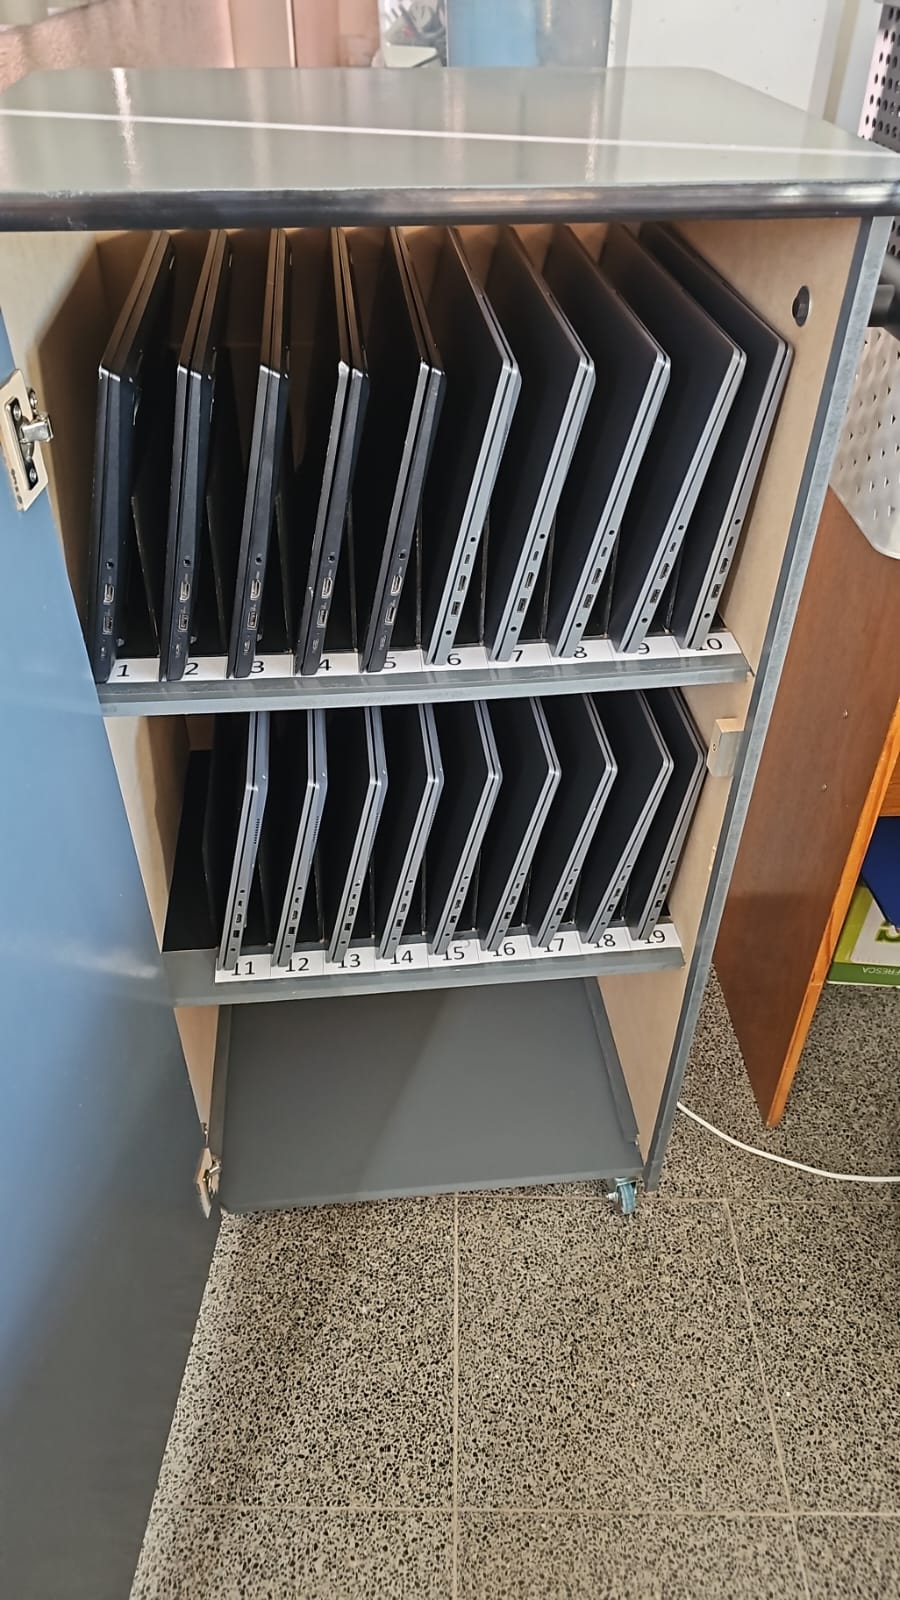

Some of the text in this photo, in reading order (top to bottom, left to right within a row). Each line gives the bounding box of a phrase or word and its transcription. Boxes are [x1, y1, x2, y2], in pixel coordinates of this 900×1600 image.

[637, 642, 650, 654] 9
[695, 638, 722, 651] 0
[512, 650, 523, 662] 7
[573, 646, 588, 659] 8
[318, 658, 332, 671] 4
[383, 656, 396, 669] 5
[447, 653, 461, 666] 6
[116, 664, 130, 677] 1
[184, 662, 199, 676] 2
[250, 661, 265, 674] 3
[390, 950, 413, 965] 14
[442, 946, 465, 961] 15
[285, 957, 309, 972] 12
[337, 953, 361, 969] 13
[231, 961, 255, 976] 11
